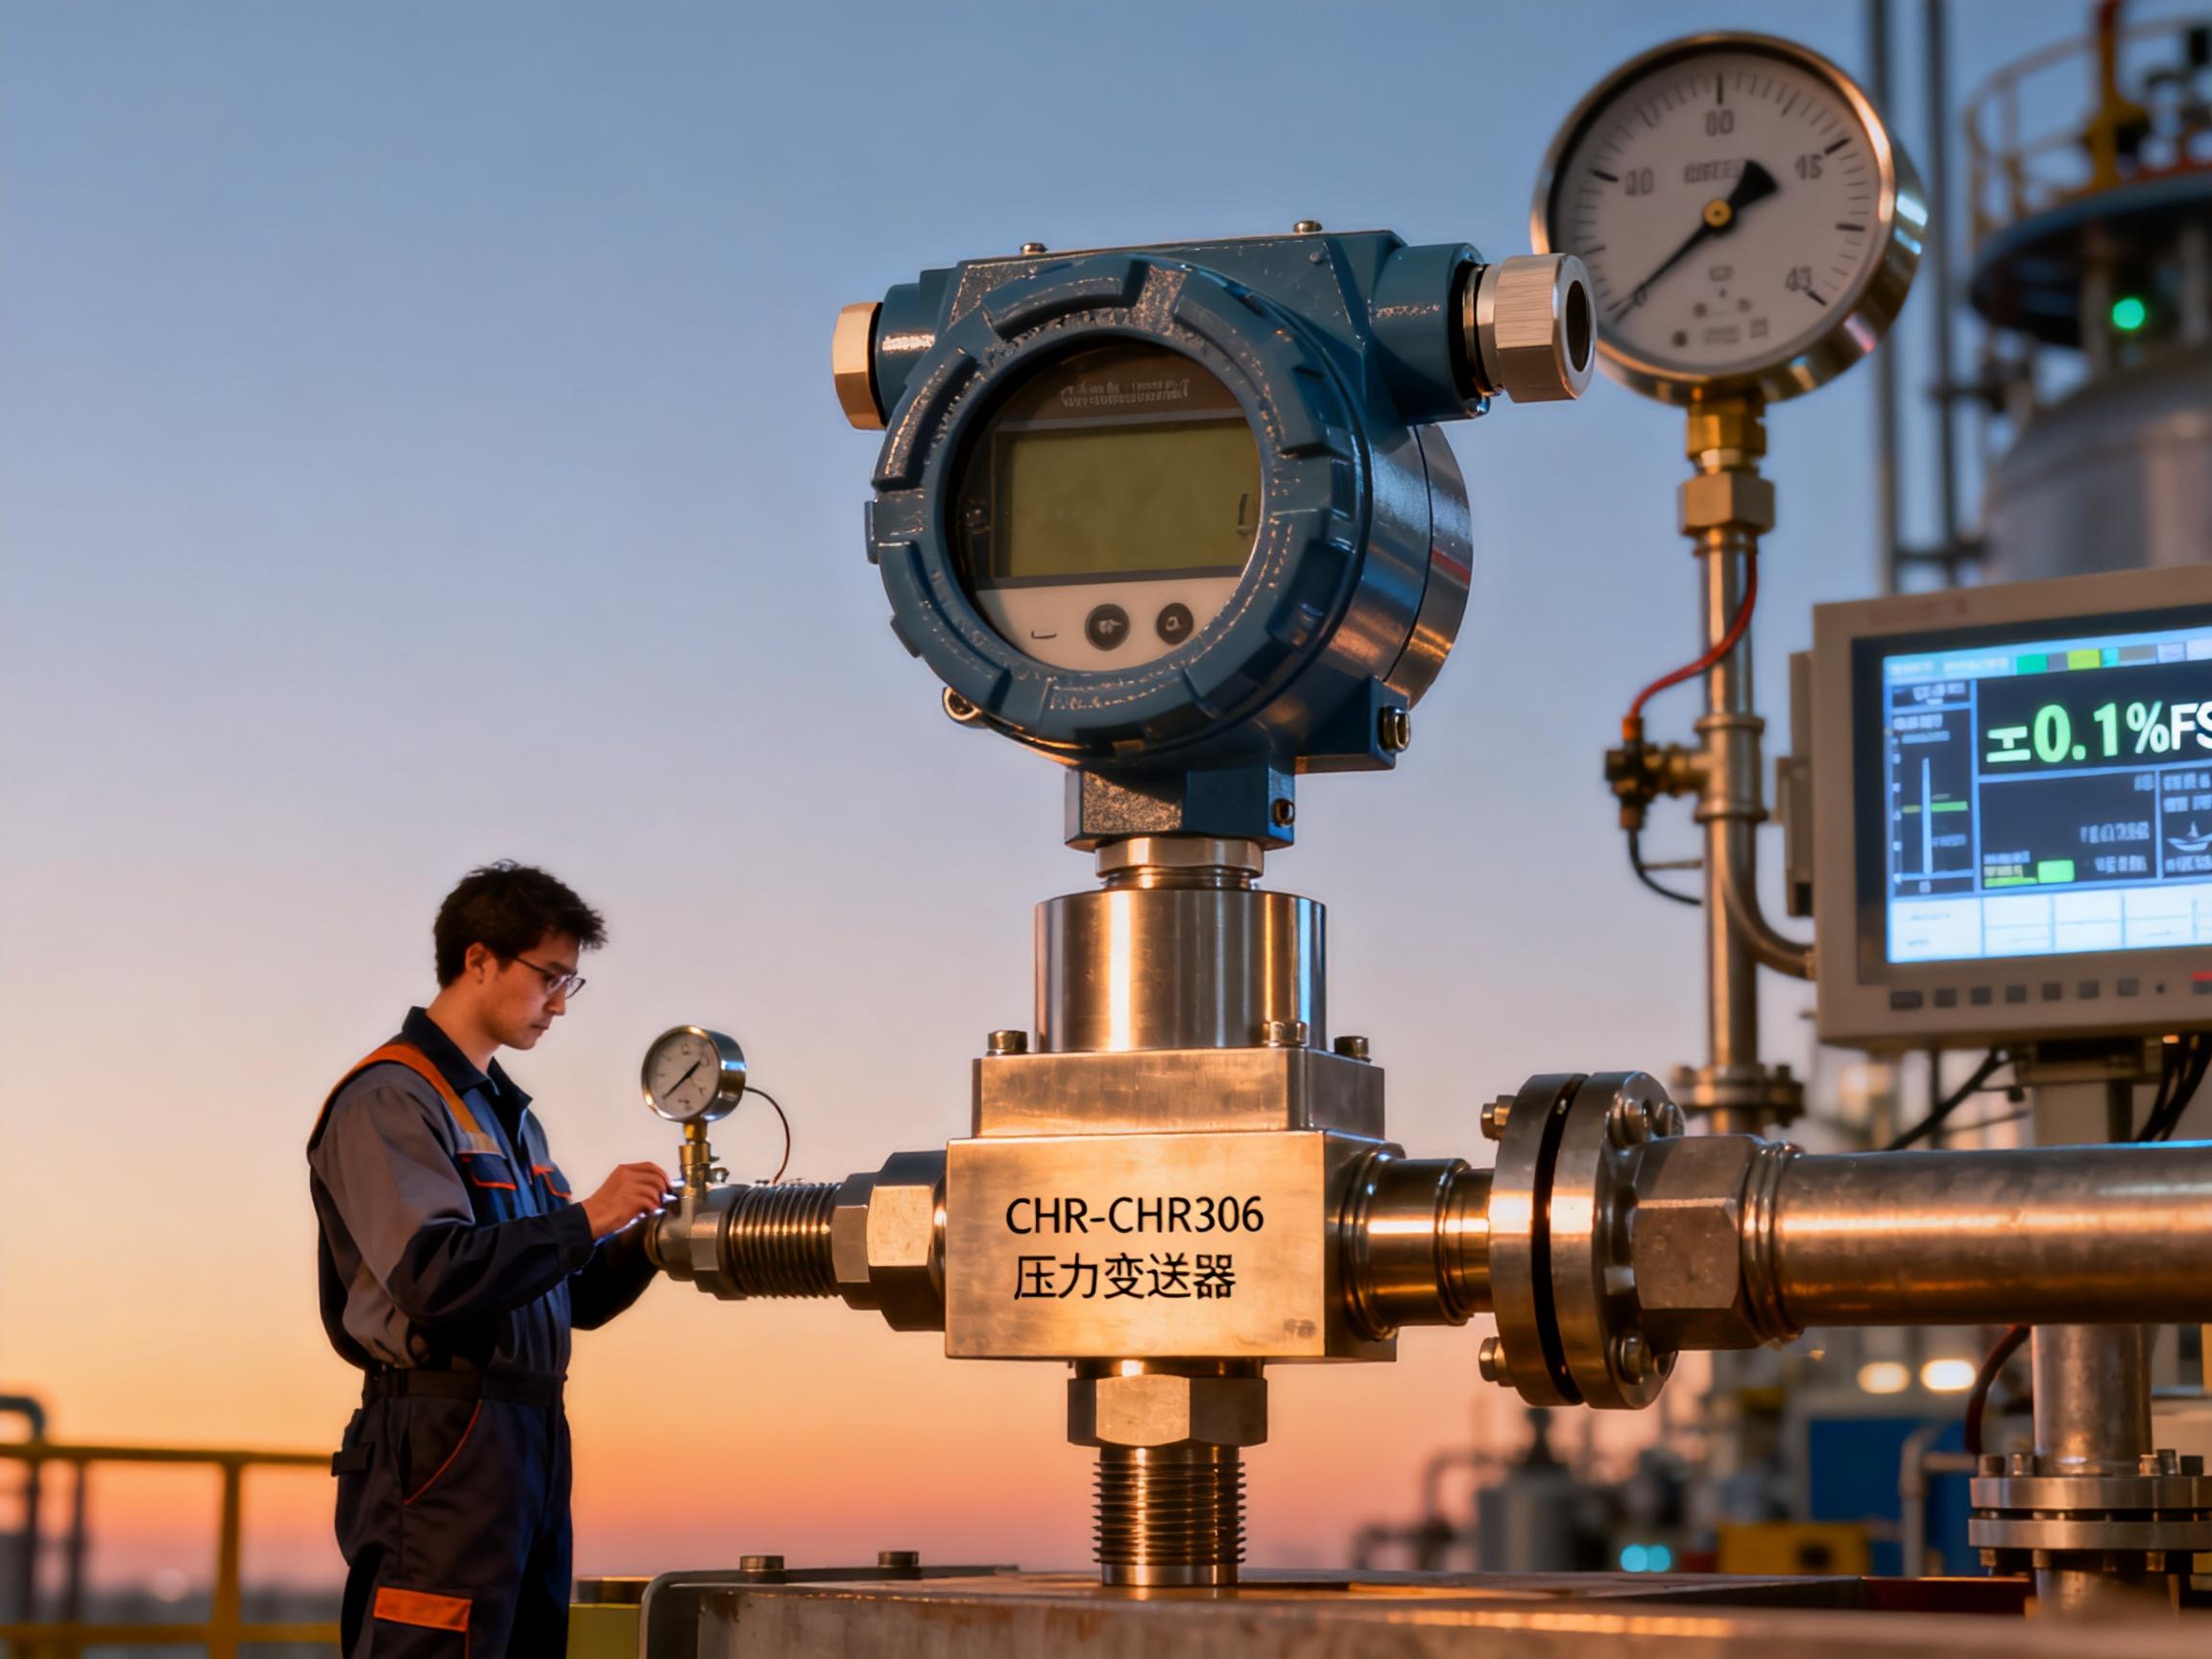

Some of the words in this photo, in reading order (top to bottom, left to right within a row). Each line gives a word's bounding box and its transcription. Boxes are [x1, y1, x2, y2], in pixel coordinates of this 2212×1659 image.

[1006, 1195, 1264, 1235] CHR-CHR306
[1013, 1252, 1237, 1301] 压力变送器
